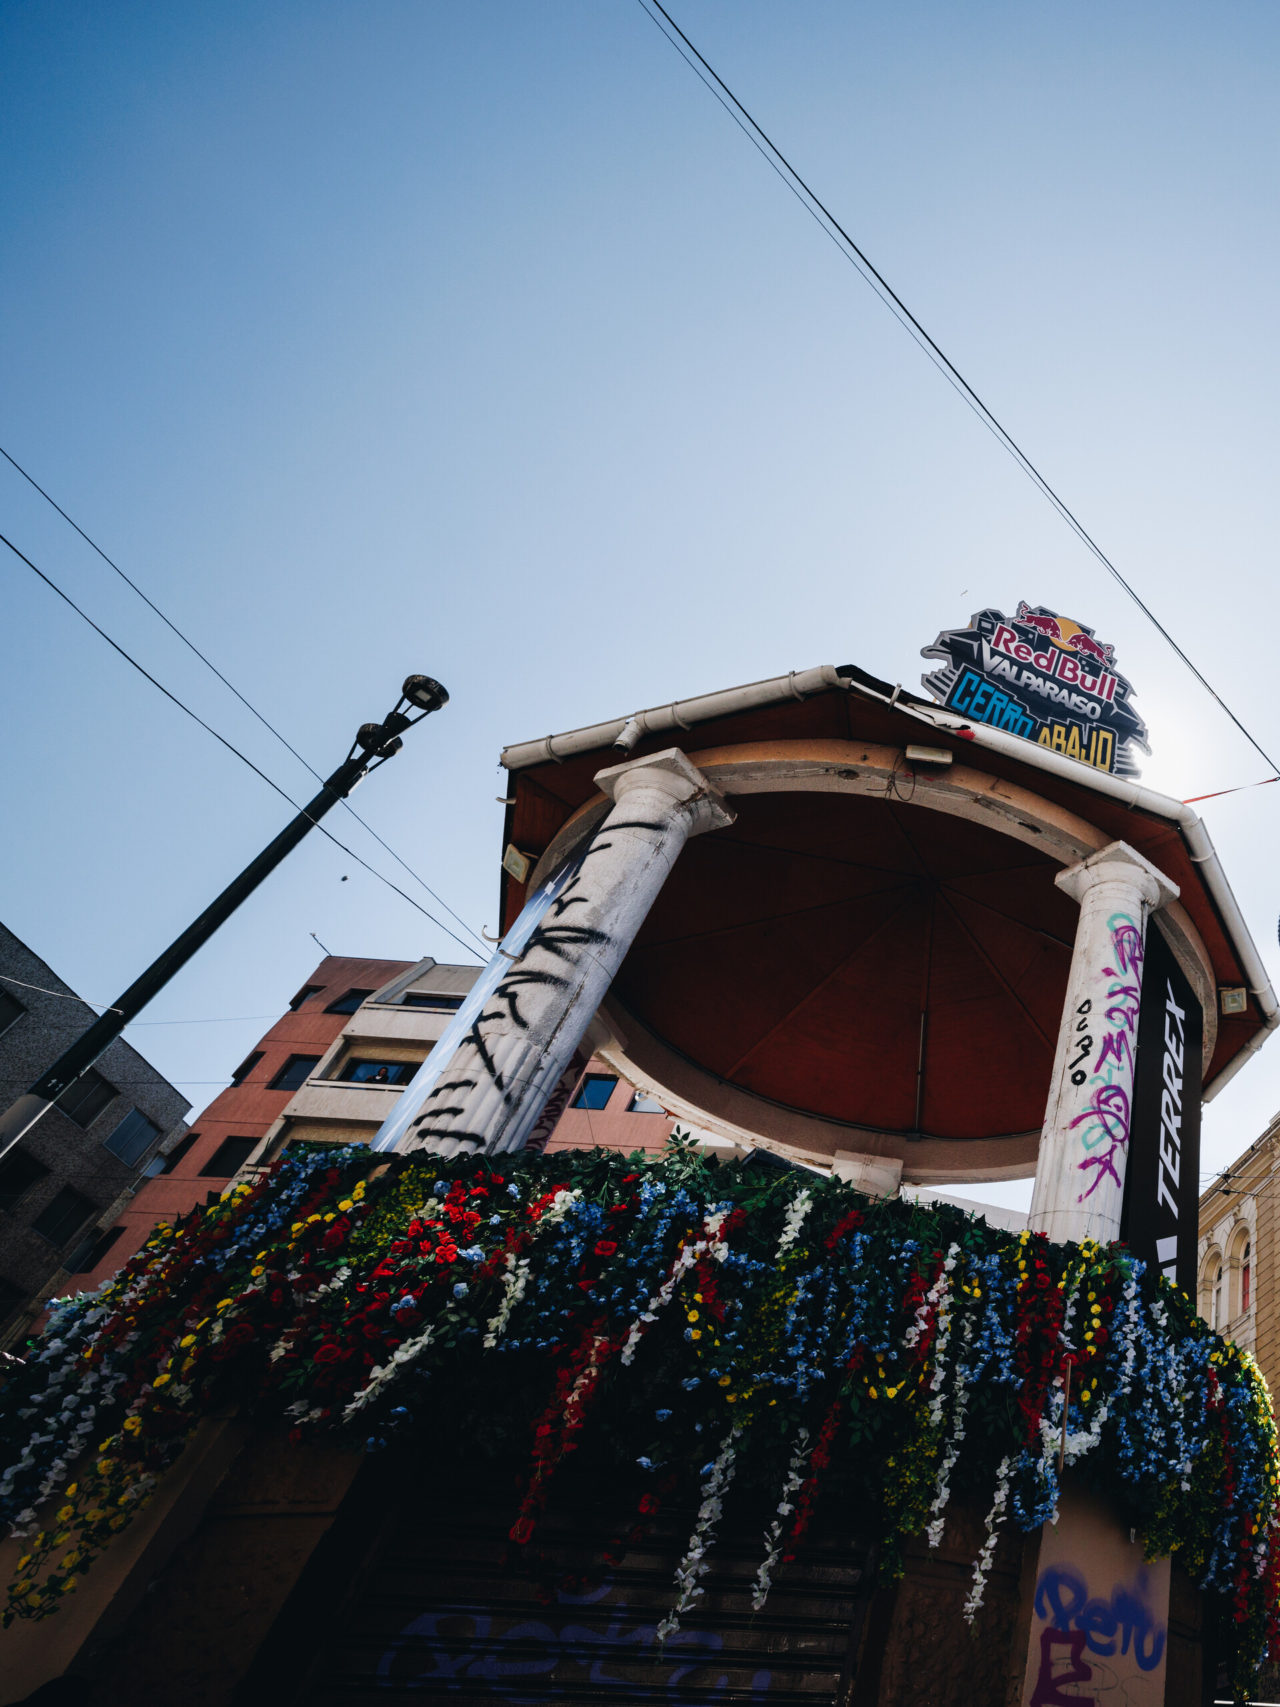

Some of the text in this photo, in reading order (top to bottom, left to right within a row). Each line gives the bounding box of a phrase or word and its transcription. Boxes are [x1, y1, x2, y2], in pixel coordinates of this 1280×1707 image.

[981, 637, 1102, 720] VALPARAISO
[990, 622, 1118, 702] Red Bull
[952, 671, 1114, 772] CERRO ABAJO
[1157, 977, 1186, 1219] TERREX
